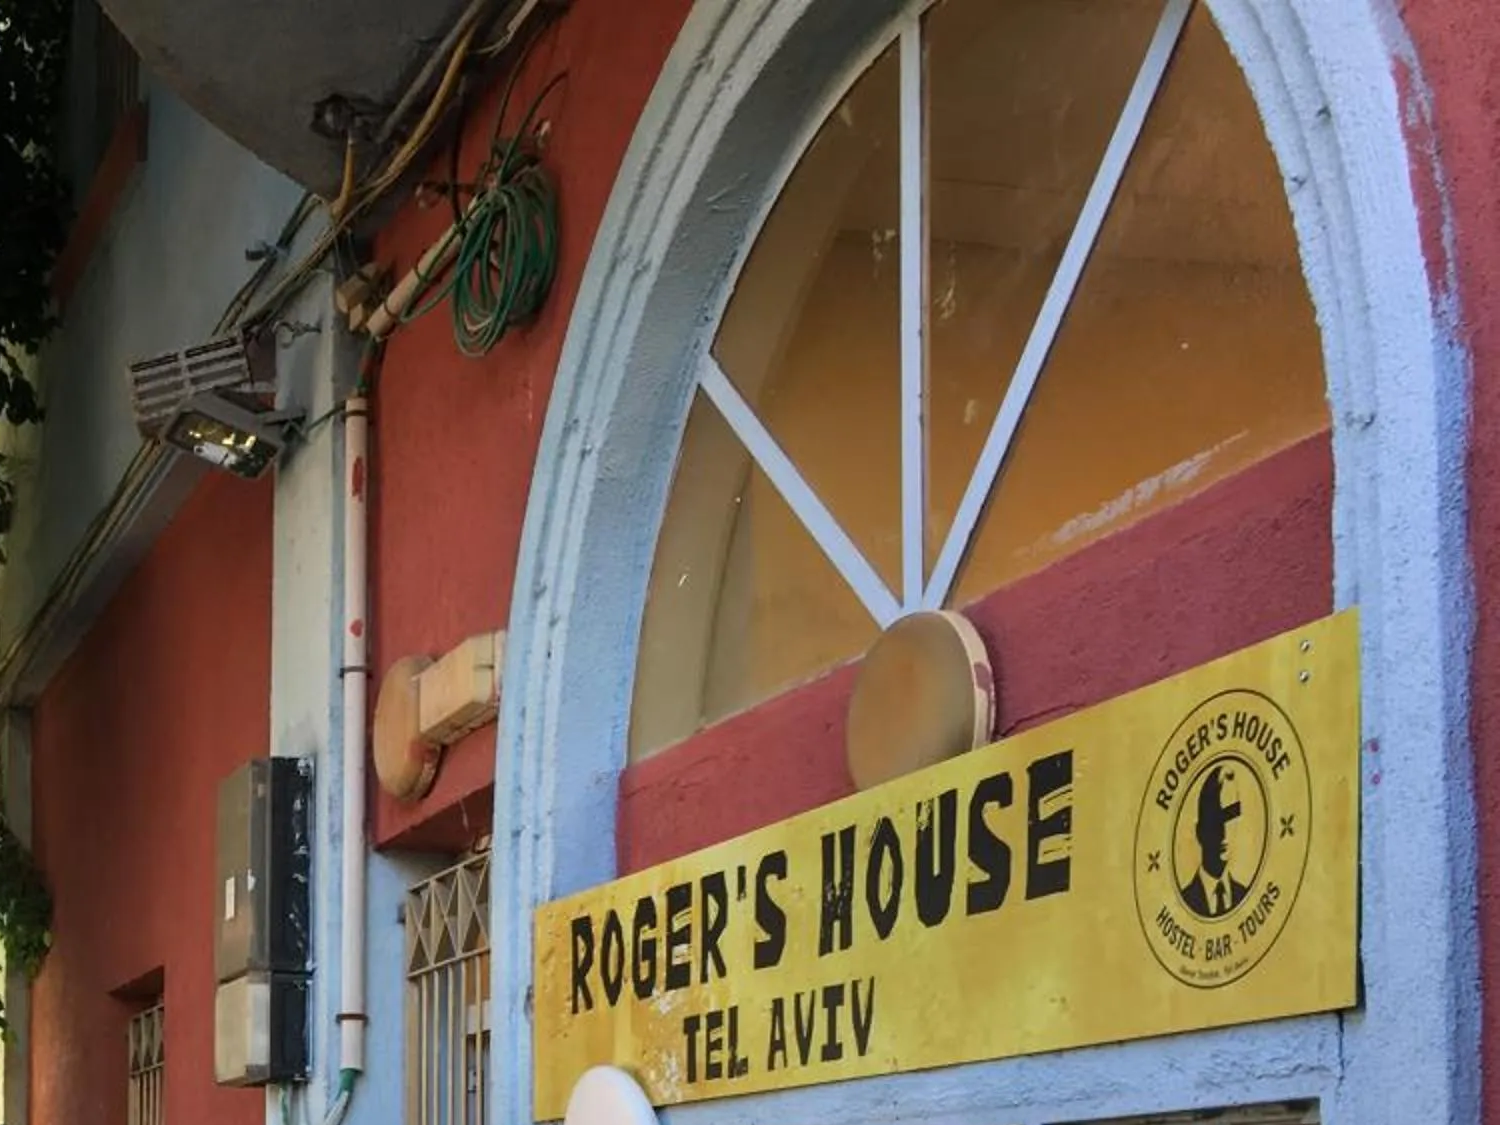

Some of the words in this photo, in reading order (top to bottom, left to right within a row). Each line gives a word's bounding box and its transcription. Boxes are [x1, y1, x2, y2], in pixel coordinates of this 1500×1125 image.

[1155, 711, 1228, 810] ROGER'S
[1231, 710, 1291, 780] HOUSE
[570, 850, 788, 1015] ROGER'S
[818, 749, 1073, 958] HOUSE
[1155, 905, 1196, 960] HOSTEL
[1205, 933, 1232, 961] BAR
[1237, 880, 1281, 945] TOURS
[683, 1005, 749, 1084] TEL
[767, 975, 875, 1072] AVIV
